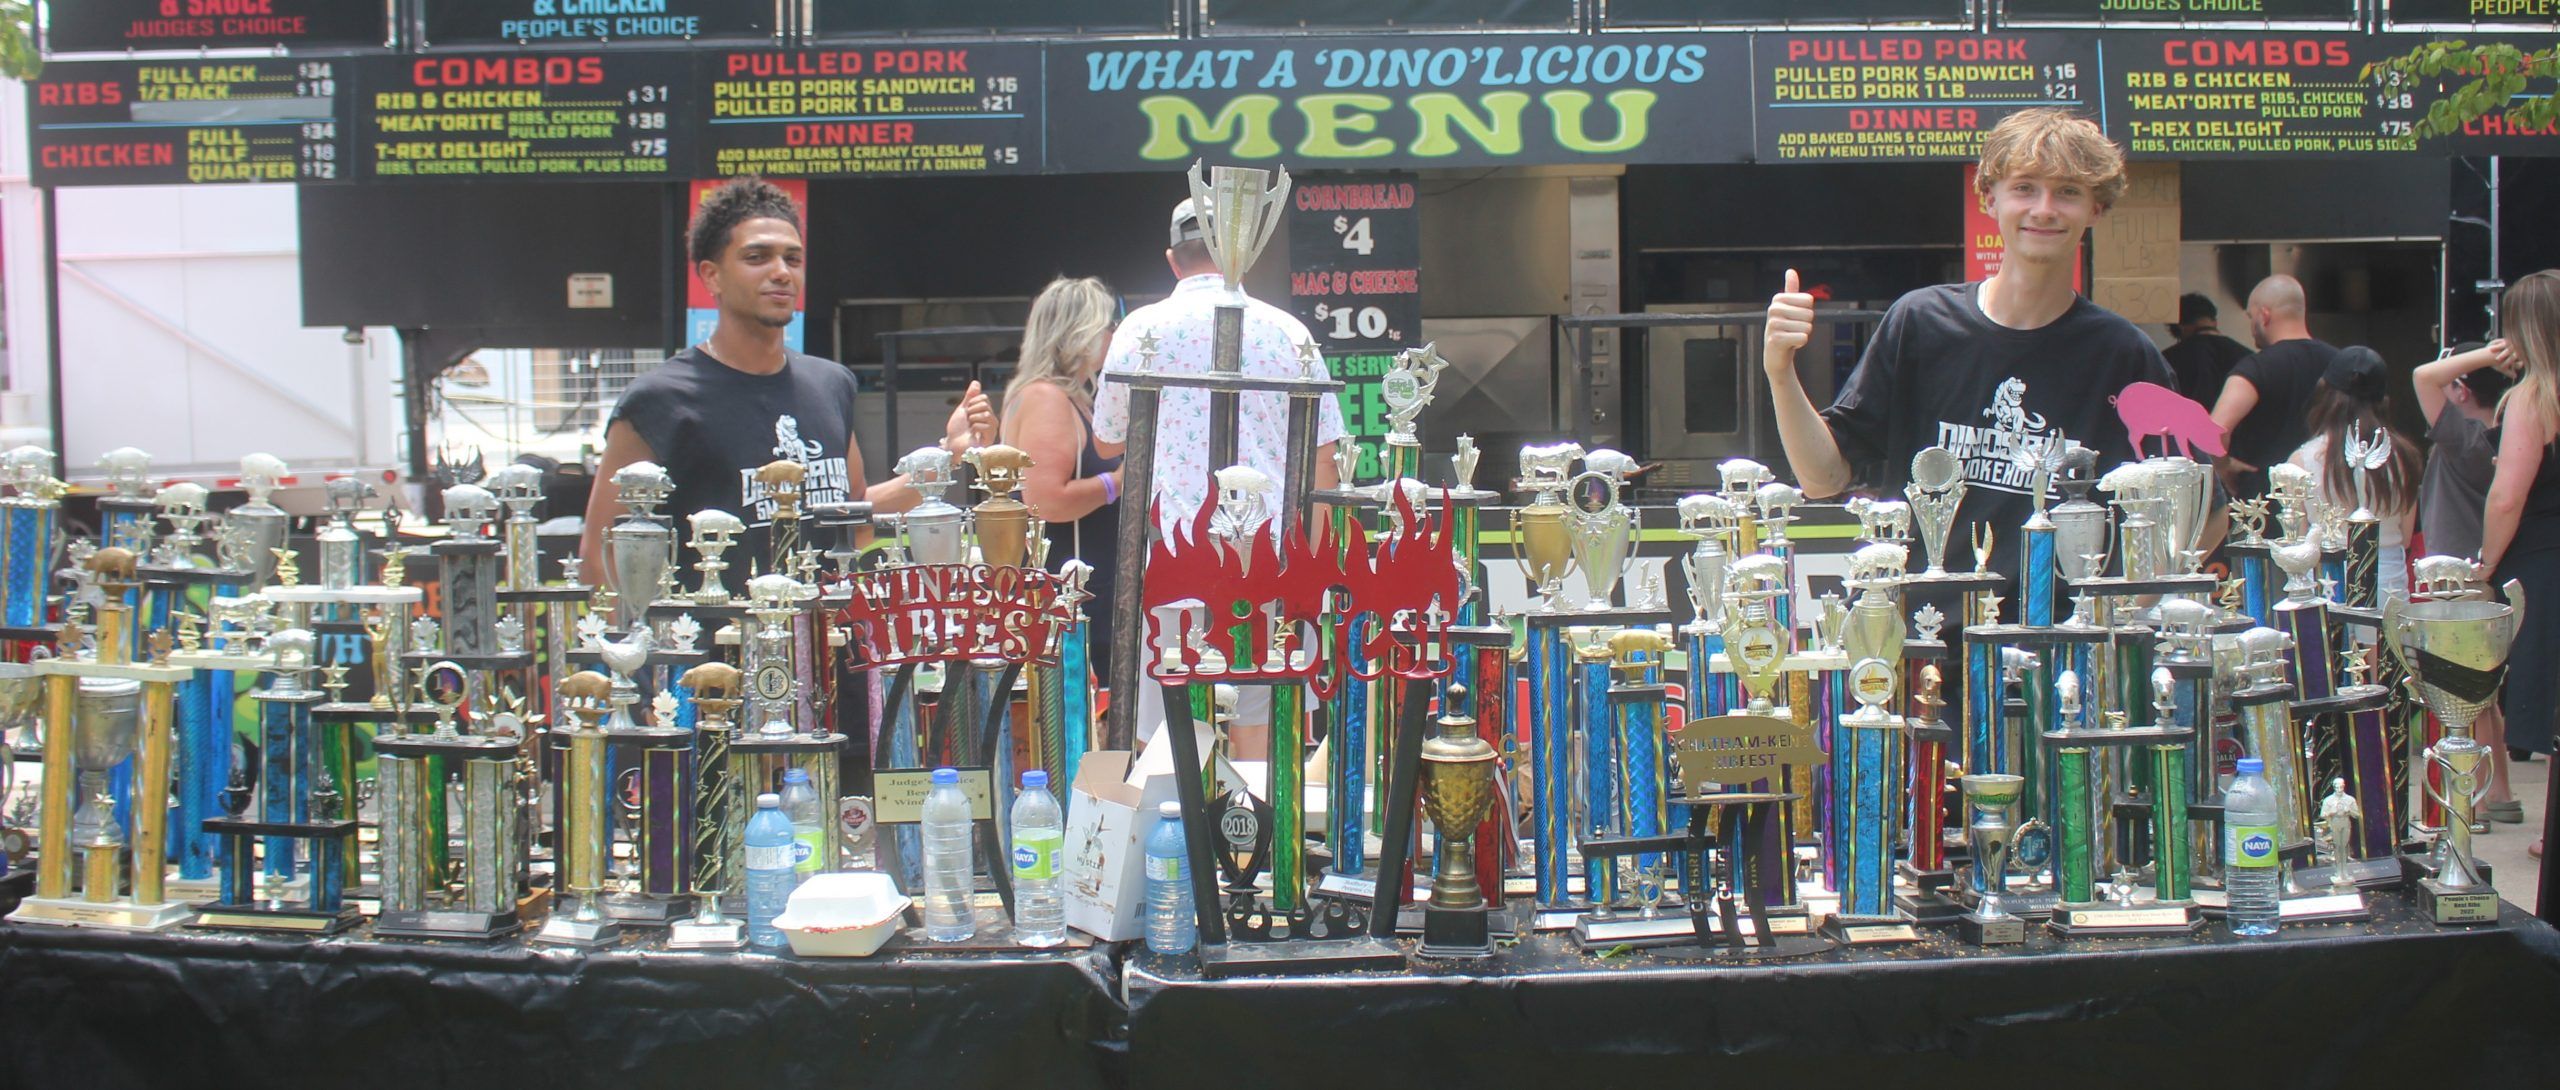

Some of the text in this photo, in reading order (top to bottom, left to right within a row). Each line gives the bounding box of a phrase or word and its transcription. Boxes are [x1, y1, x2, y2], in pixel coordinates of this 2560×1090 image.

[125, 16, 307, 39] JUDGES CHOICE
[501, 16, 699, 39] PEOPLE'S CHOICE
[1788, 38, 2028, 62] PULLED PORK
[2164, 40, 2350, 67] COMBOS
[413, 57, 604, 86] COMBOS
[728, 50, 968, 76] PULLED PORK
[1086, 48, 1255, 91] WHAT
[1258, 49, 1297, 89] A
[1775, 63, 2077, 83] PULLED PORK SANDWICH $16
[138, 66, 194, 84] FULL
[200, 65, 256, 83] RACK
[2127, 73, 2170, 89] RIB
[2173, 73, 2188, 88] &
[2194, 72, 2290, 88] CHICKEN
[39, 81, 123, 106] RIBS
[139, 84, 169, 101] 1/2
[175, 83, 229, 101] RACK
[714, 76, 1018, 98] PULLED PORK SANDWICH $16
[1775, 83, 2077, 100] PULLED PORK 1 LB $21
[376, 92, 417, 110] RIB
[421, 92, 438, 109] &
[443, 90, 541, 109] CHICKEN
[714, 95, 1013, 116] PULLED PORK 1 LB $21
[2128, 93, 2256, 111] 'MEAT'ORITE
[2261, 93, 2300, 107] RIBS,
[2303, 92, 2368, 106] CHICKEN,
[508, 111, 549, 127] RIBS,
[551, 110, 621, 126] CHICKEN,
[1849, 109, 1977, 130] DINNER
[2262, 105, 2362, 119] PULLED PORK
[508, 125, 614, 140] PULLED PORK
[786, 122, 914, 146] DINNER
[1138, 89, 1659, 160] MENU
[2130, 121, 2412, 137] T-REX DELIGHT $75
[188, 129, 247, 146] FULL
[1779, 132, 1806, 145] ADD
[1809, 132, 1853, 145] BAKED
[1857, 131, 1903, 144] BEANS
[1917, 131, 1973, 144] CREAMY
[2132, 140, 2170, 153] RIBS,
[2174, 139, 2236, 153] CHICKEN,
[2239, 139, 2291, 152] PULLED
[2295, 139, 2335, 153] PORK,
[2338, 138, 2373, 151] PLUS
[42, 143, 174, 168] CHICKEN
[188, 146, 249, 163] HALF
[376, 142, 437, 160] T-REX
[441, 141, 531, 160] DELIGHT
[717, 149, 744, 162] ADD
[748, 147, 791, 161] BAKED
[794, 146, 839, 160] BEANS
[853, 145, 909, 159] CREAMY
[911, 143, 985, 158] COLESLAW
[1779, 146, 1796, 158] TO
[1799, 145, 1826, 158] ANY
[1830, 145, 1868, 158] MENU
[1872, 144, 1905, 157] ITEM
[1909, 144, 1926, 157] TO
[1929, 143, 1967, 157] MAKE
[188, 162, 296, 181] QUARTER
[376, 161, 414, 176] RIBS,
[482, 159, 536, 174] PULLED
[583, 158, 622, 173] PLUS
[624, 157, 667, 173] SIDES
[717, 157, 987, 175] TO ANY MENU ITEM TO MAKE IT A DINNER
[1296, 183, 1414, 211] CORNBREAD
[1333, 215, 1374, 255] $4
[1291, 270, 1418, 295] MAC & CHEESE
[1315, 302, 1387, 339] $10
[853, 563, 1046, 612] WINDSOR
[846, 607, 1060, 672] RIBFEST
[1149, 583, 1456, 693] Ribfest
[1223, 816, 1256, 837] 2018
[2244, 841, 2271, 851] NAYA
[1014, 852, 1036, 864] NAYA
